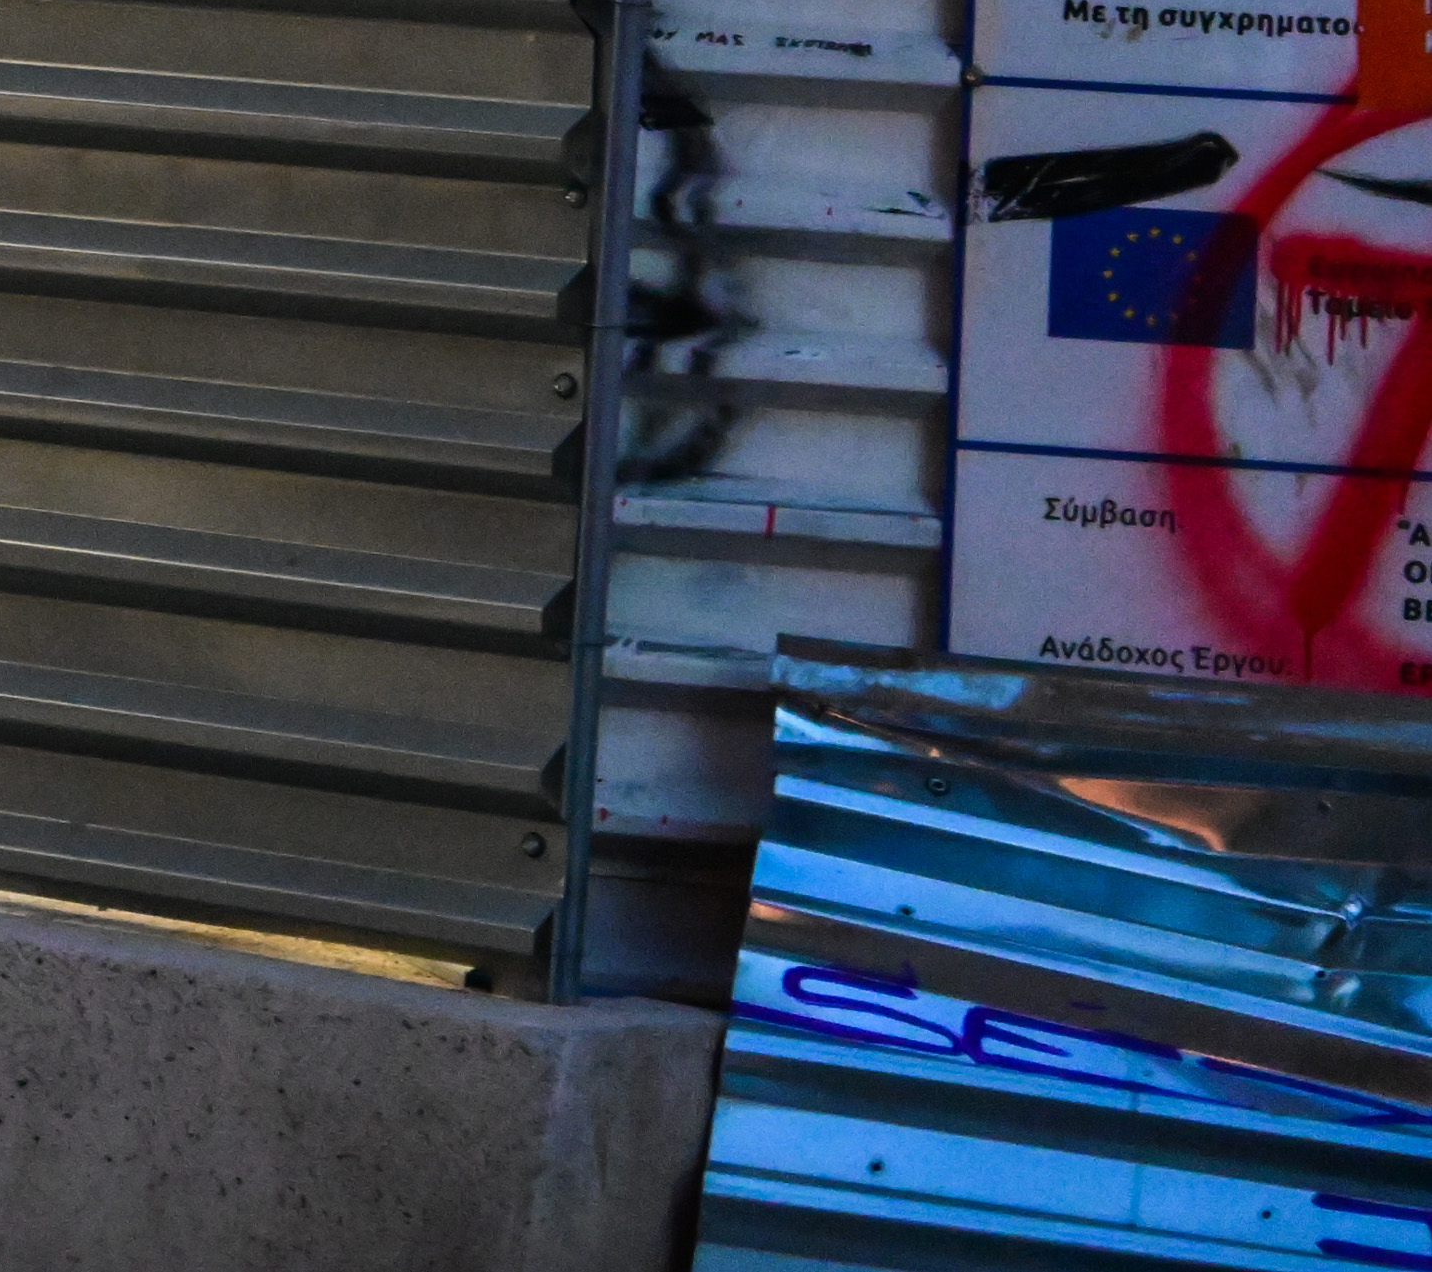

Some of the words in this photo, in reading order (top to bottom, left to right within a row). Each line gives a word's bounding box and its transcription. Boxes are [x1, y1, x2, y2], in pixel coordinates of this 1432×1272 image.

[1116, 6, 1149, 30] τη
[1158, 8, 1361, 37] συγχρηματο
[1038, 634, 1184, 673] Ανάδοχος
